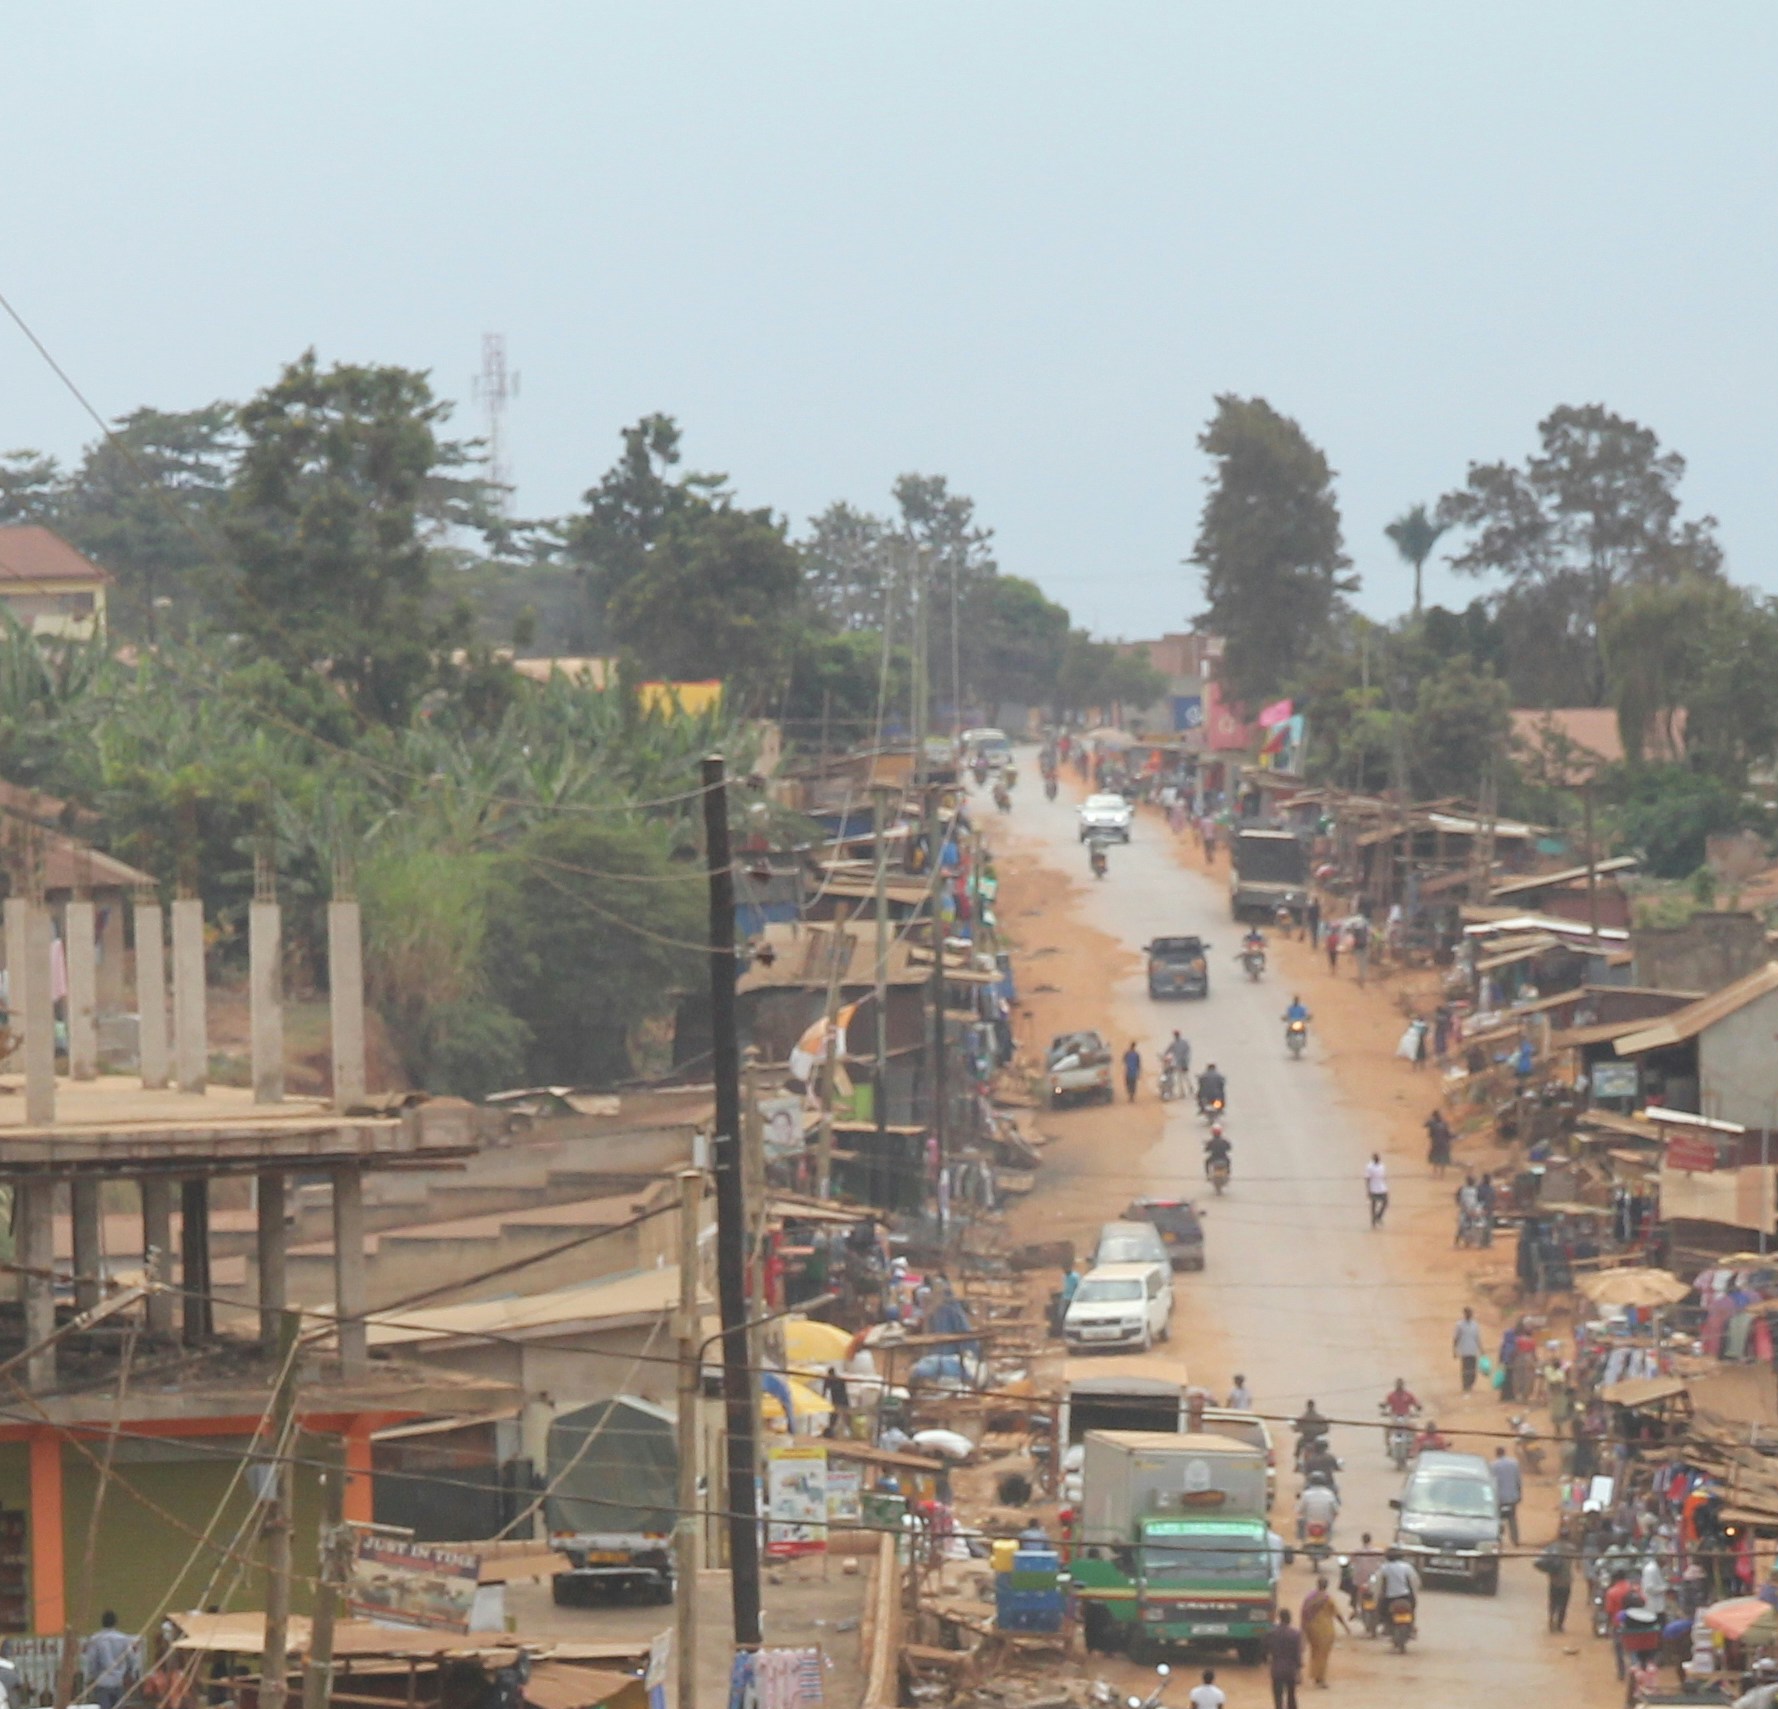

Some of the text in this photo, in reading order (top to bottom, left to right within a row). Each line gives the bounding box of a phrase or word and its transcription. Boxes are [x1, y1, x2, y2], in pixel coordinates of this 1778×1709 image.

[363, 1538, 477, 1569] JUST IN TIME
